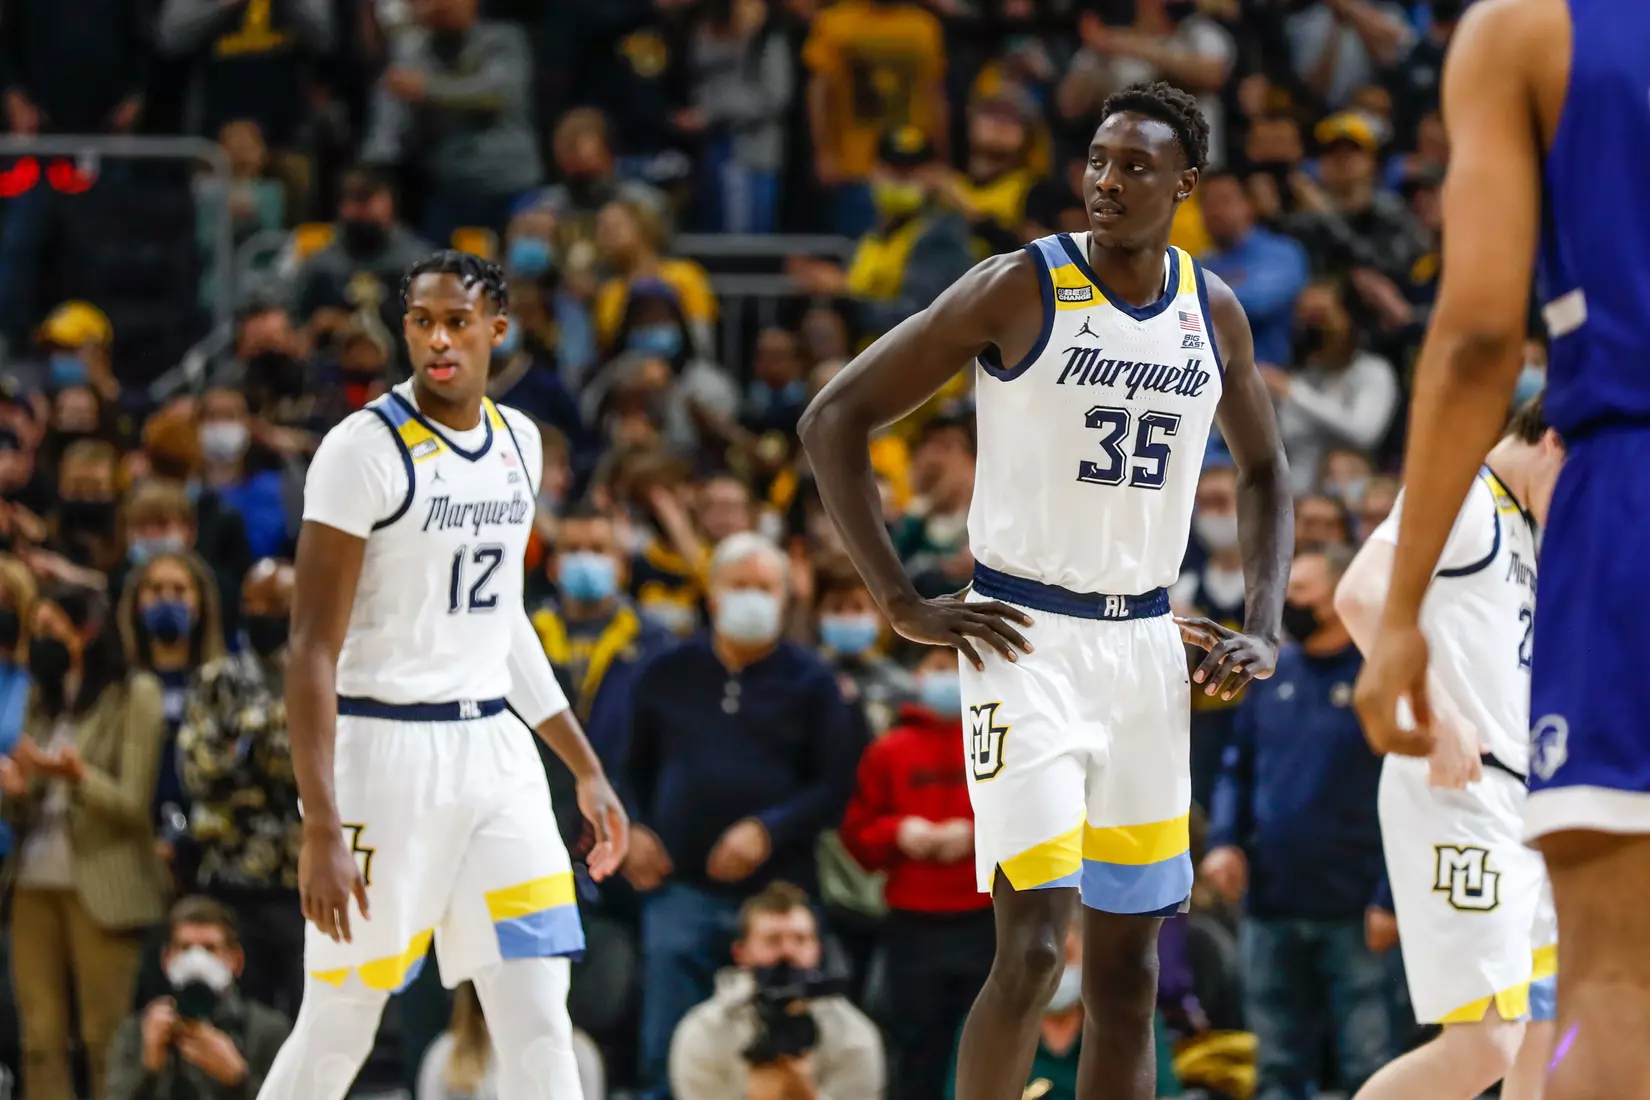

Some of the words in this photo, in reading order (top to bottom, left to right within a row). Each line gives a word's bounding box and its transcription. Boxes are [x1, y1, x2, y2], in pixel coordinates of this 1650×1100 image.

[1056, 347, 1210, 400] Marquette
[1181, 340, 1206, 348] EAST
[1076, 405, 1182, 490] 35
[421, 490, 528, 536] Marquette
[447, 543, 505, 614] 12
[969, 701, 1012, 783] MU
[1432, 844, 1501, 913] MU
